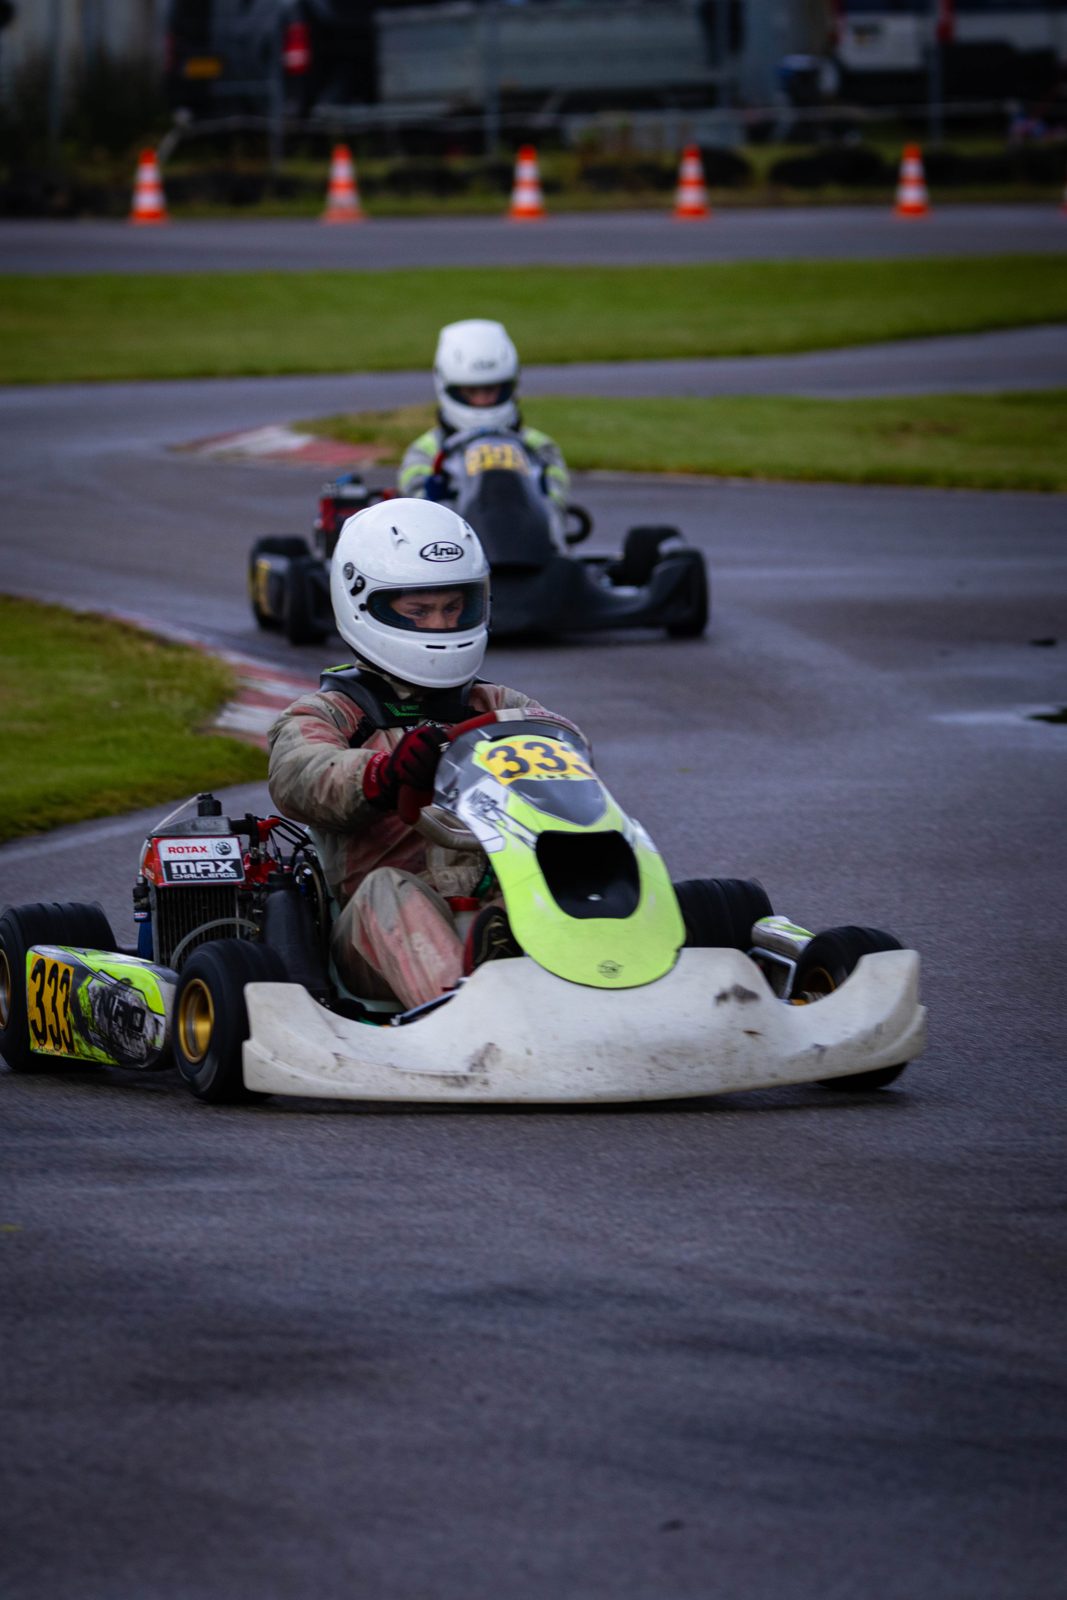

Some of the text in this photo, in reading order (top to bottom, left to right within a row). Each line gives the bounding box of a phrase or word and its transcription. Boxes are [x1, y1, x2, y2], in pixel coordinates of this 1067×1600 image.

[426, 543, 460, 557] Arai
[167, 845, 208, 854] ROTAX
[169, 860, 236, 873] MAX
[172, 872, 238, 880] CHALLENGE
[30, 958, 75, 1054] 333
